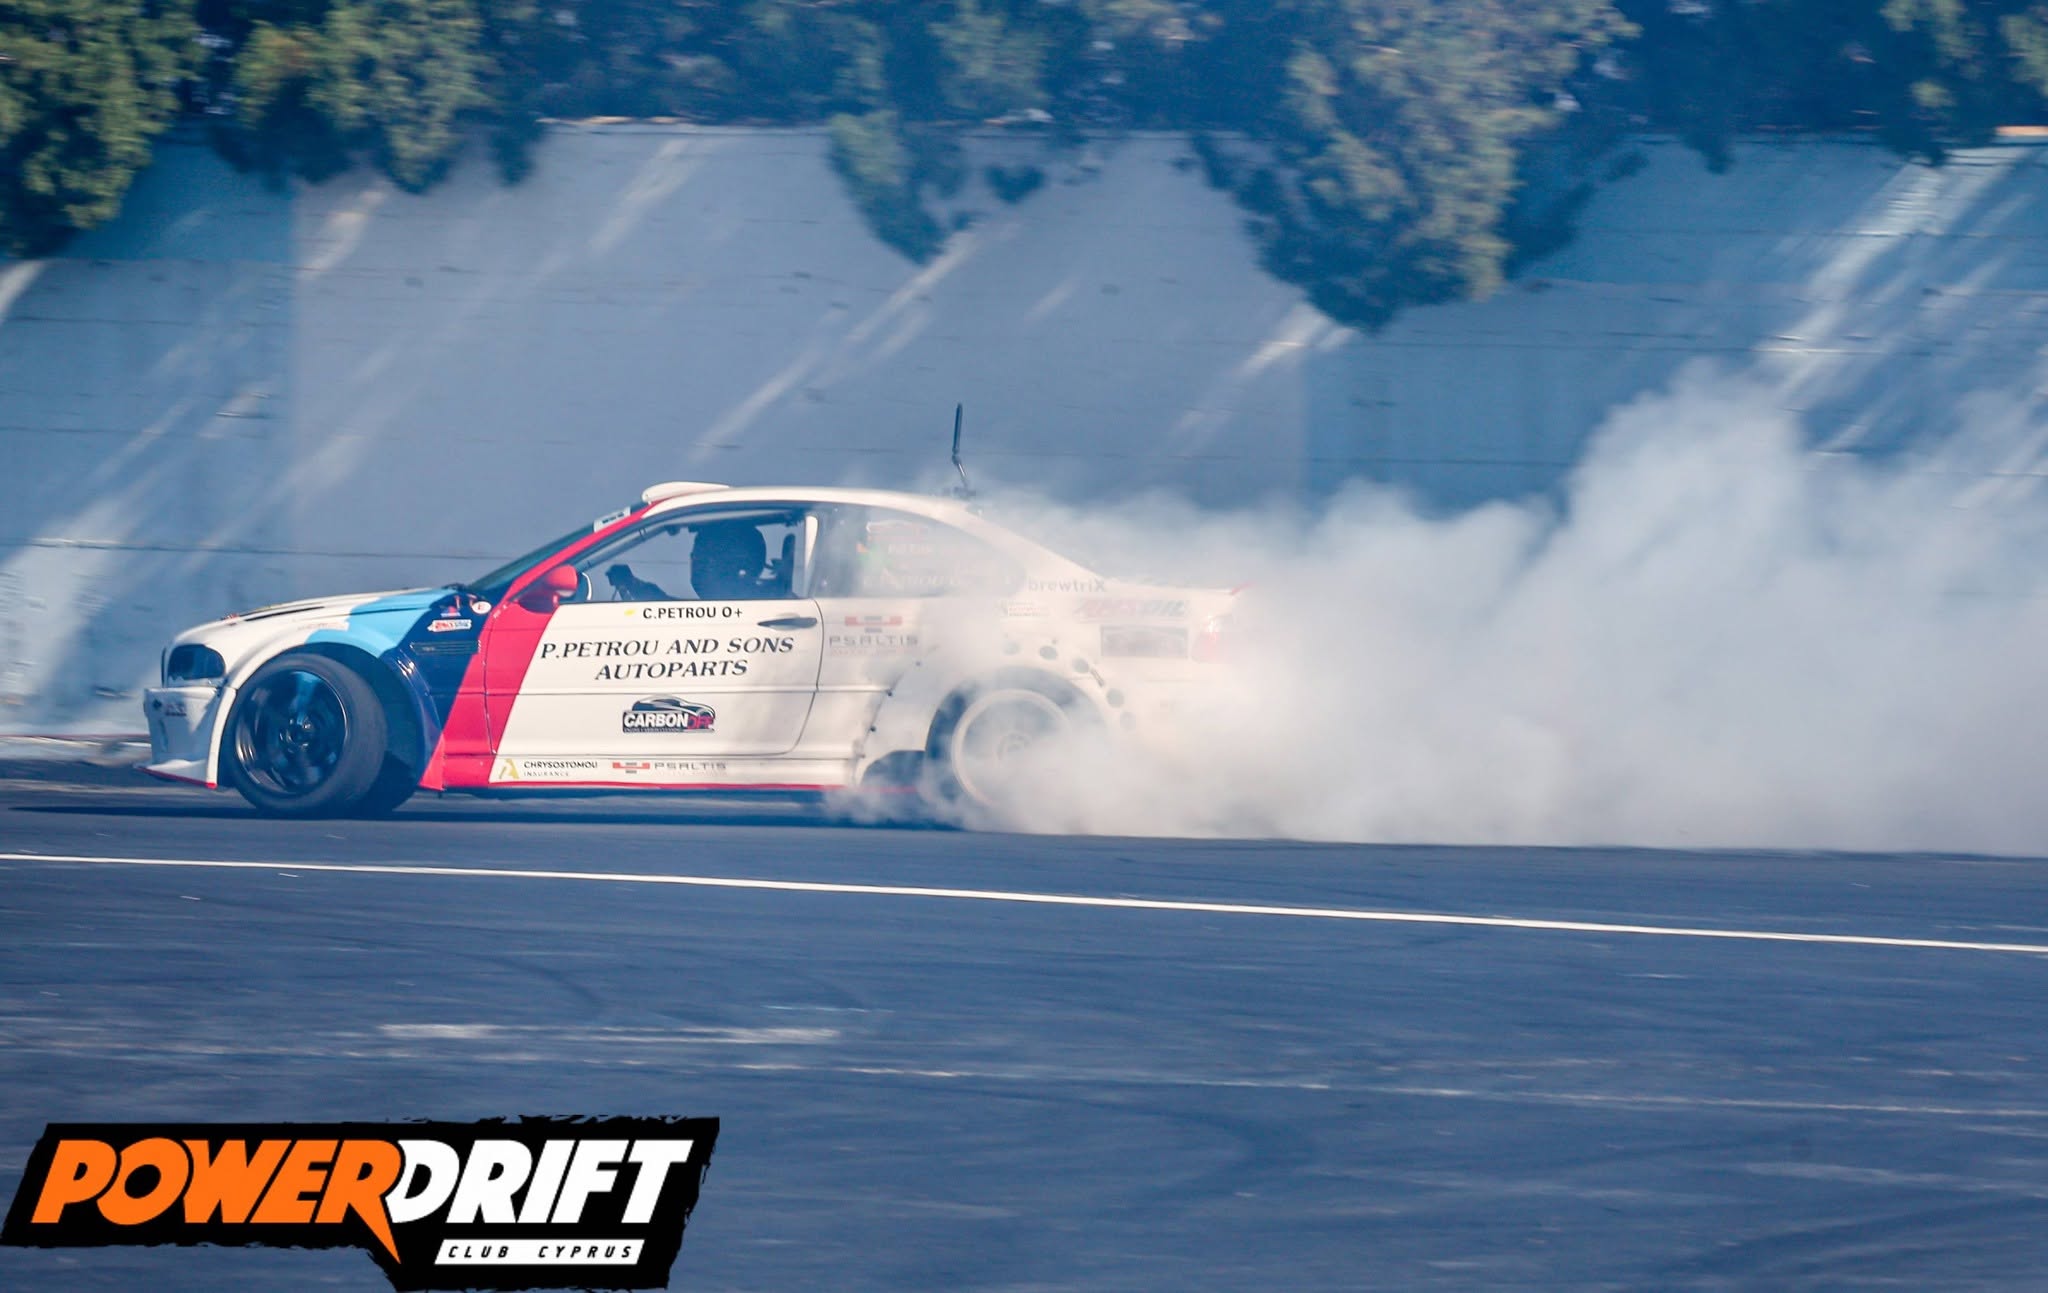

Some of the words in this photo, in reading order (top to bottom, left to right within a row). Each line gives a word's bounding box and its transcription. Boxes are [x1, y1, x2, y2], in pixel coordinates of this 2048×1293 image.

[642, 606, 716, 619] C.PETROU
[540, 640, 659, 659] P.PETROU
[666, 638, 719, 655] AND
[727, 636, 795, 653] SONS
[829, 635, 918, 648] PSALTIS
[595, 659, 748, 681] AUTOPARTS
[524, 761, 598, 769] CHRYSOSTOMOU
[655, 762, 727, 770] PSALTIS
